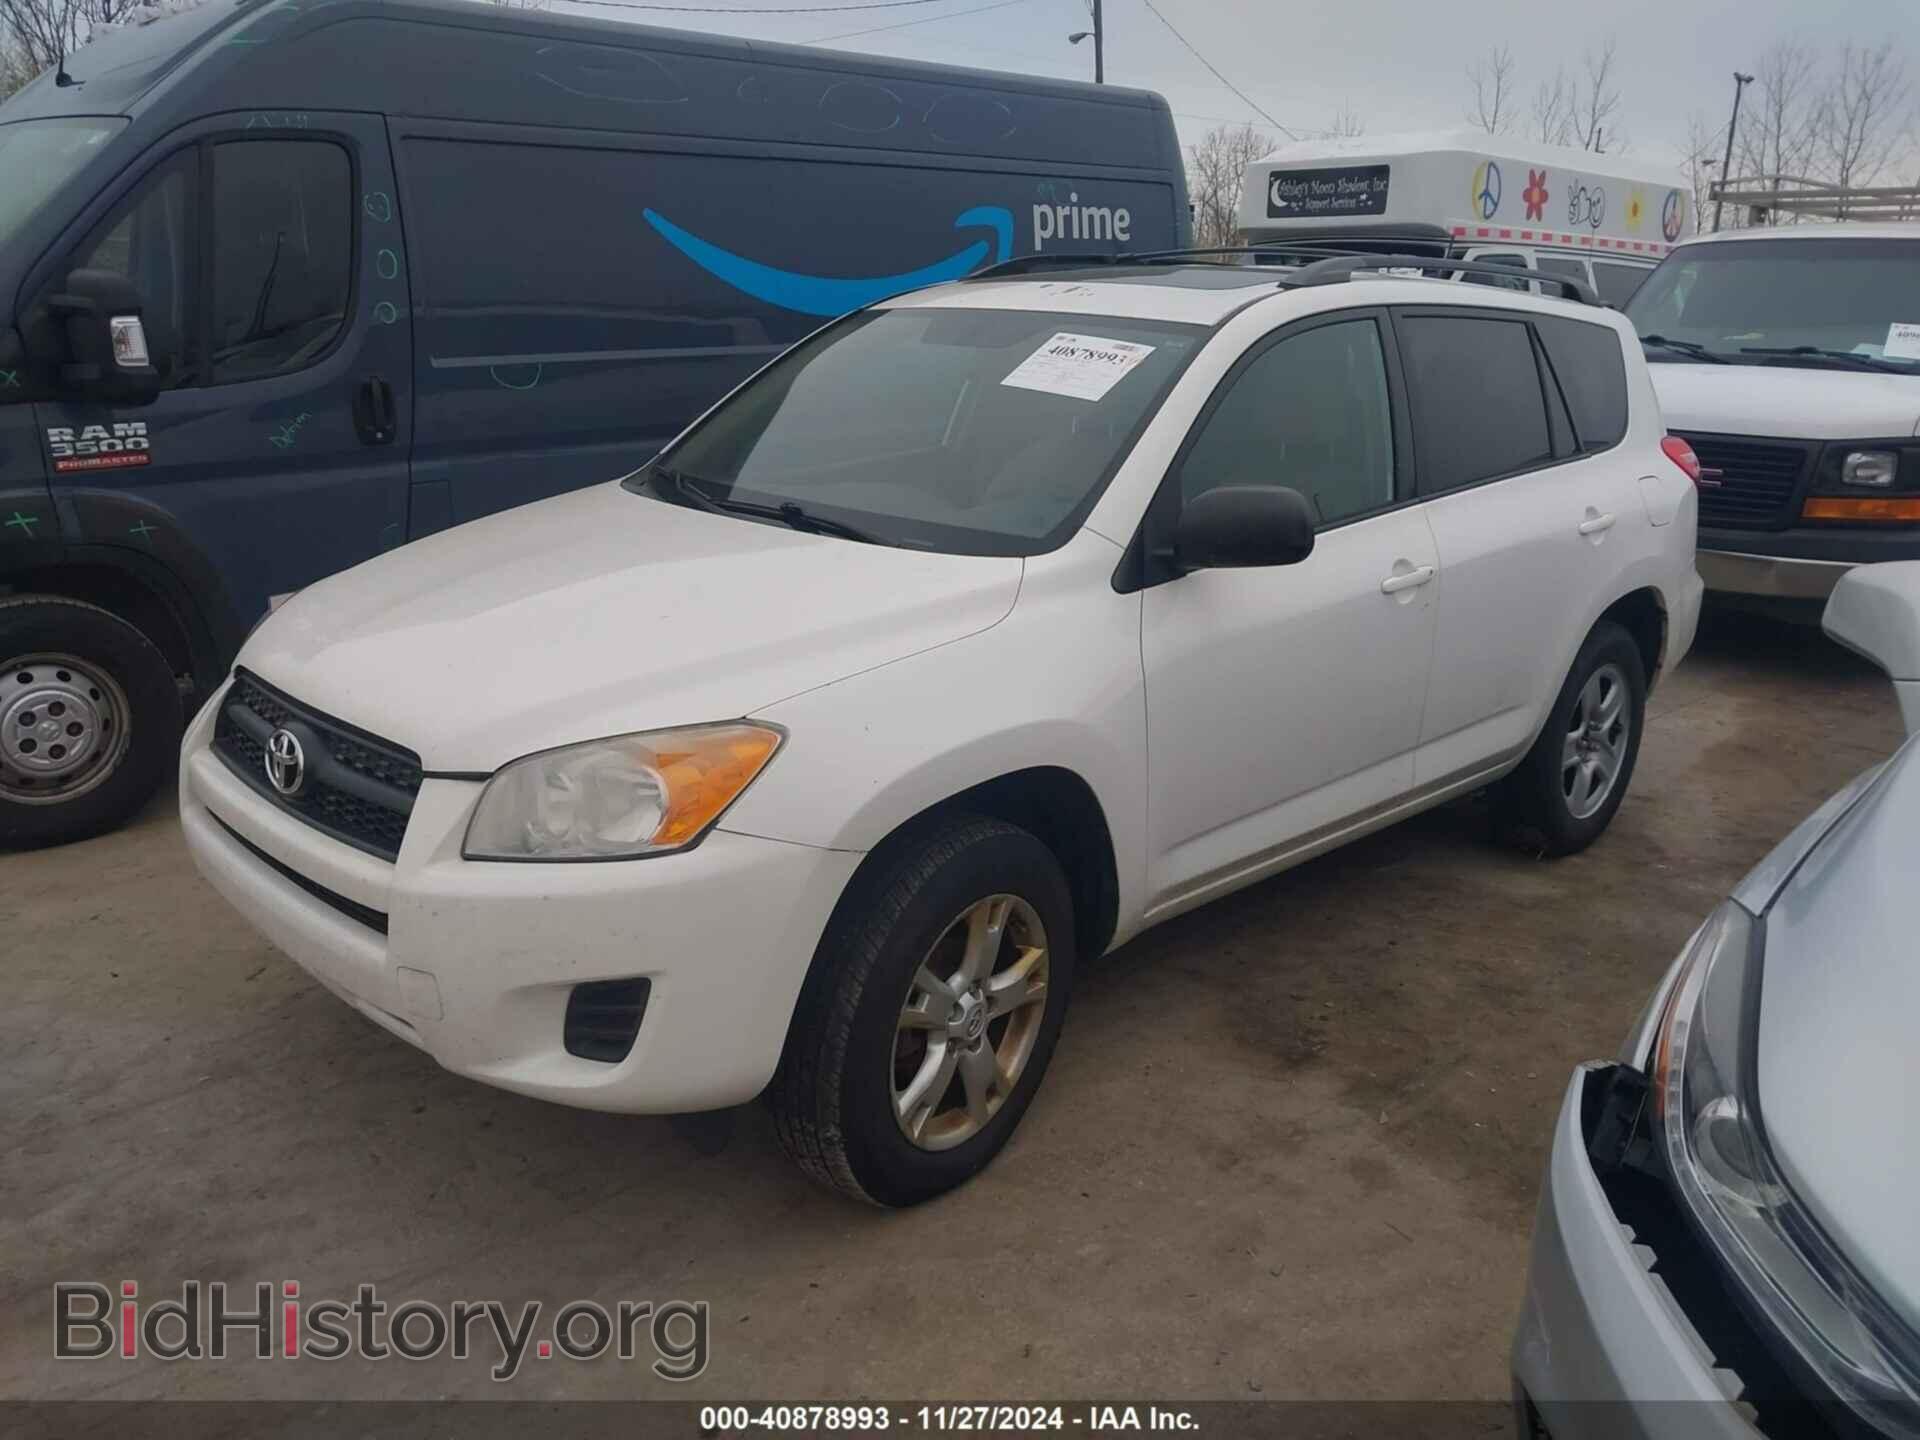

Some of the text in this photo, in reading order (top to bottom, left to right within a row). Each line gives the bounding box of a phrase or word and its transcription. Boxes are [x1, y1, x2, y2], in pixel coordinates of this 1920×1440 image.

[1032, 192, 1131, 252] prime
[1048, 344, 1128, 366] 40878993
[47, 422, 147, 442] RAM
[49, 437, 150, 457] 3500
